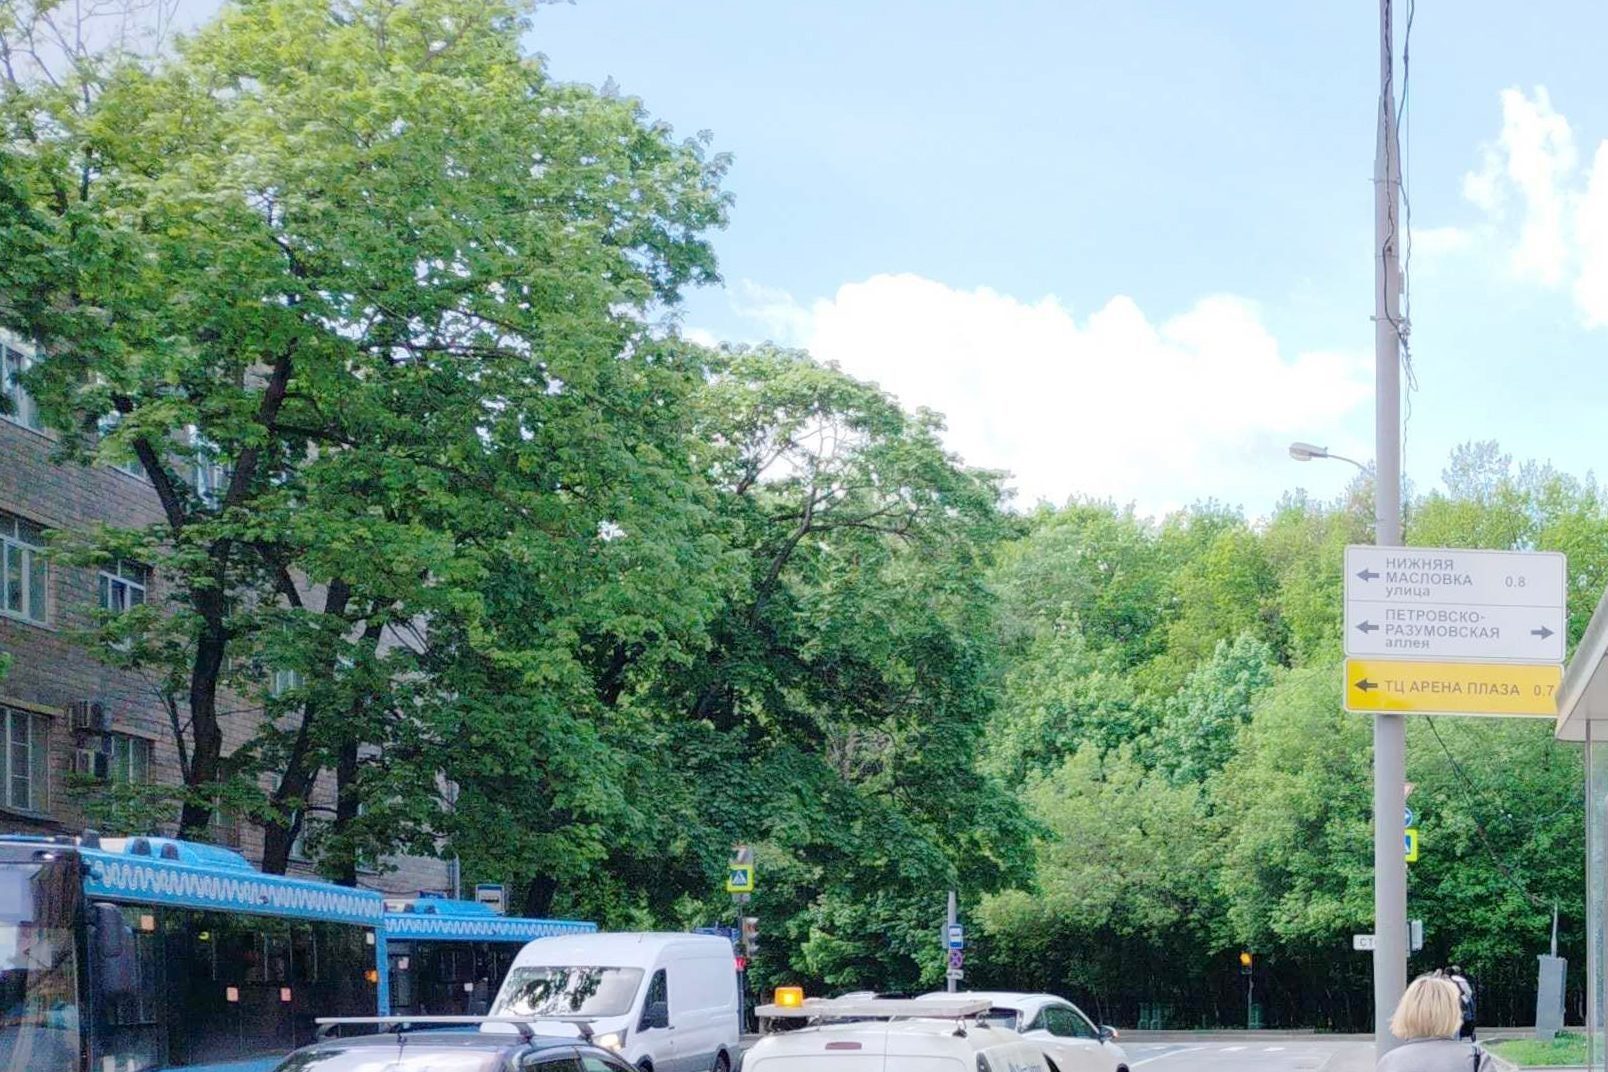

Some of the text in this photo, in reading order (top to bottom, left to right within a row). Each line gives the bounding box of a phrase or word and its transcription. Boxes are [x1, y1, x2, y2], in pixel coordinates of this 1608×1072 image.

[1385, 557, 1454, 571] НИЖНЯЯ
[1385, 571, 1473, 586] МАСЛОВКА
[1505, 576, 1526, 588] 0.8
[1385, 586, 1431, 598] улица
[1385, 608, 1487, 623] ПЕТРОВСКО-
[1385, 624, 1500, 639] РАЗУМОВСКАЯ
[1385, 639, 1430, 650] аллея
[1384, 679, 1405, 694] ТЦ
[1409, 681, 1463, 695] АРЕНА
[1467, 682, 1521, 696] ПЛАЗА
